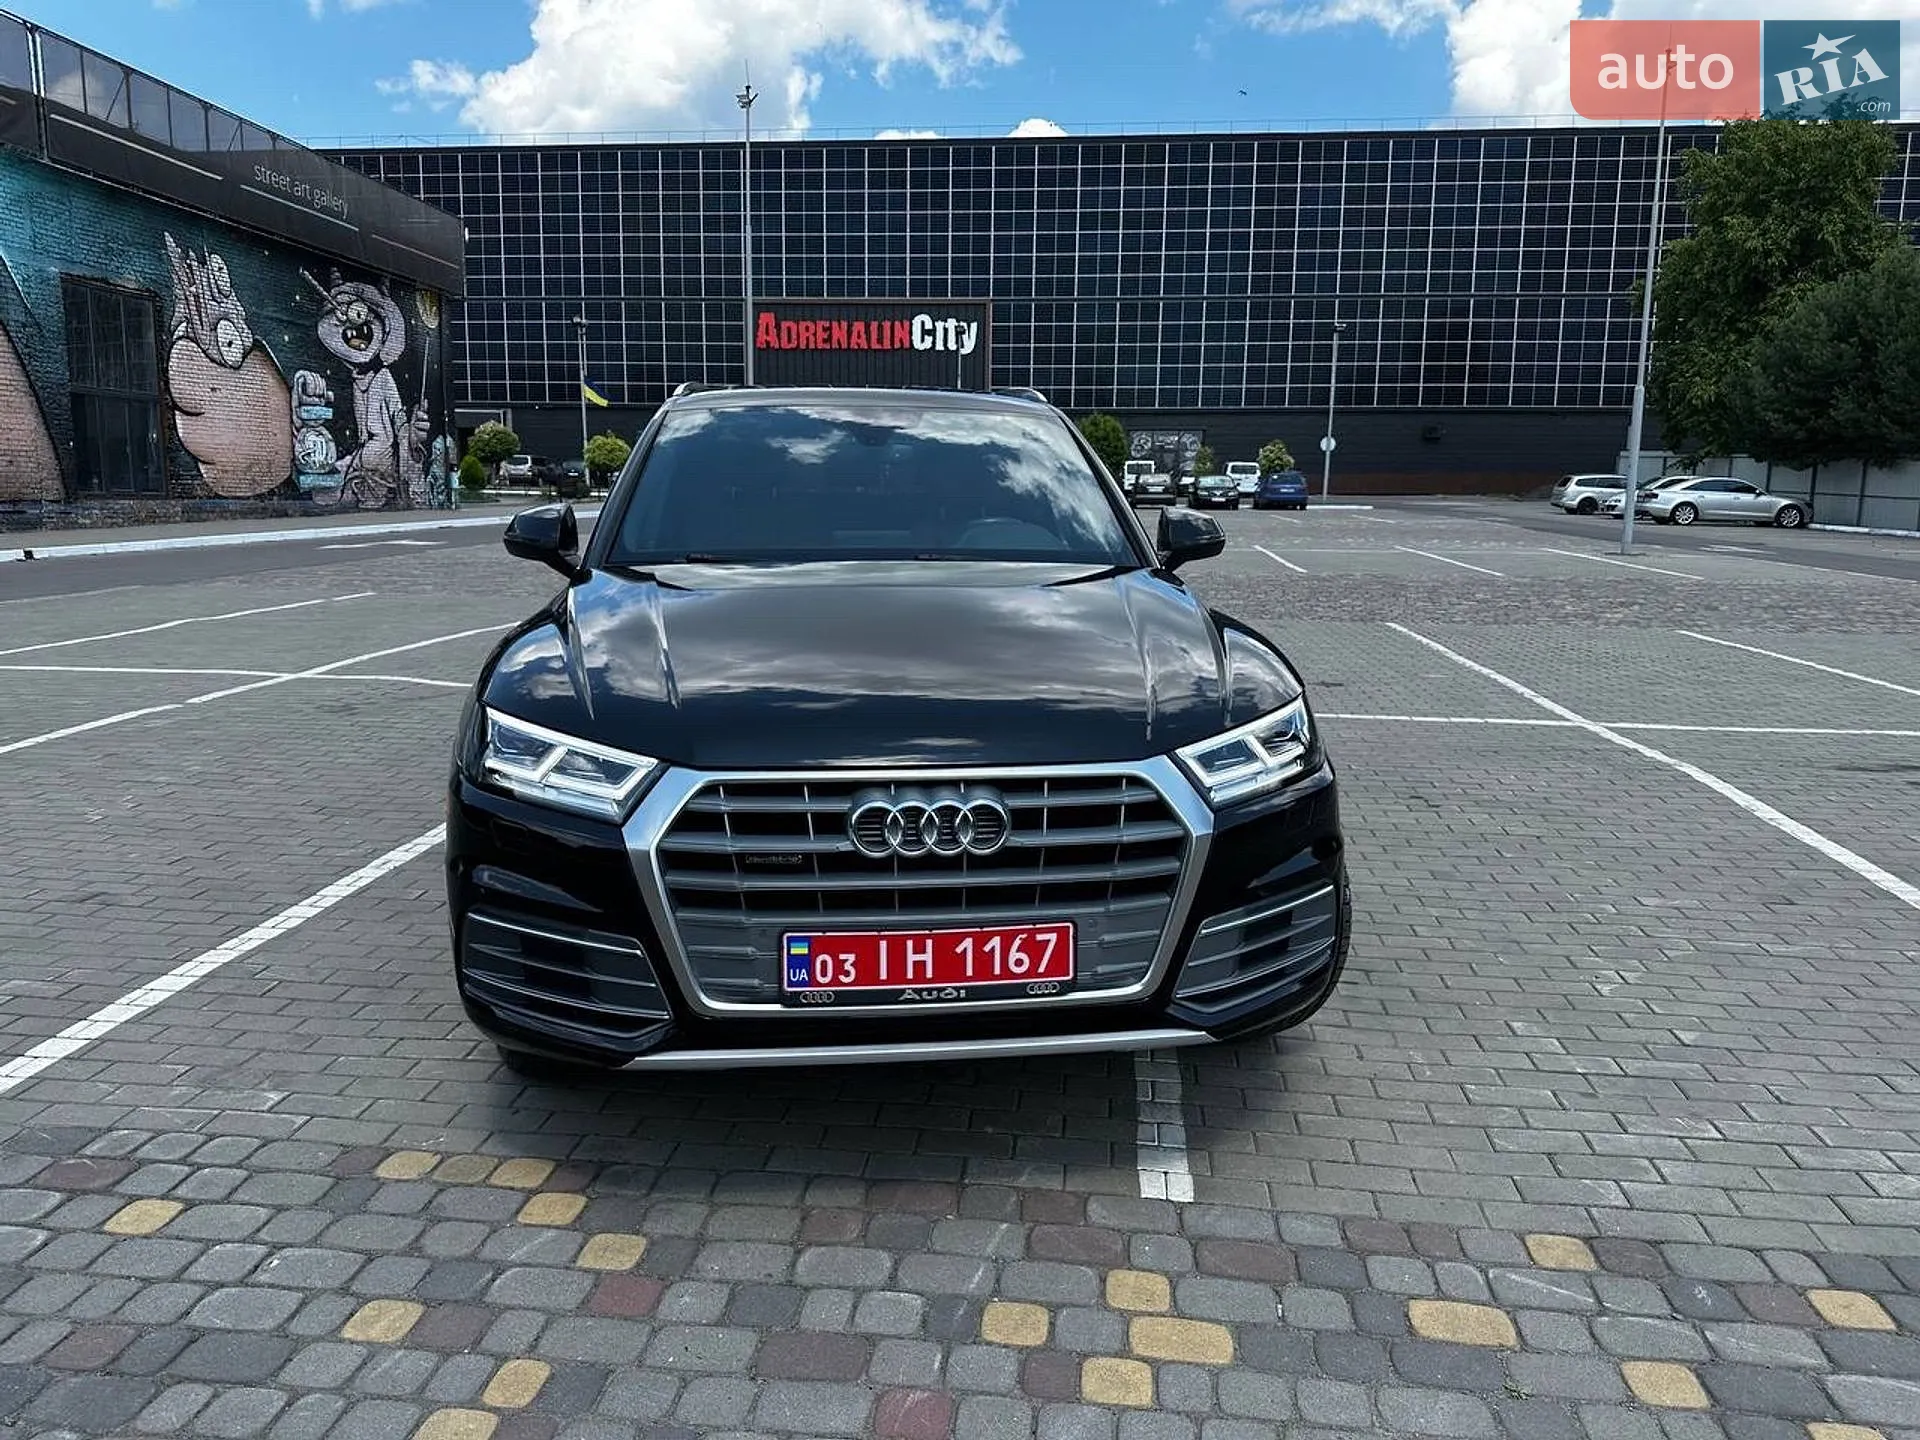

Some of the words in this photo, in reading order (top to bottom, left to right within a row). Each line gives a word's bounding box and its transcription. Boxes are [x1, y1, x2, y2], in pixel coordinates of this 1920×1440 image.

[253, 164, 291, 193] street
[293, 181, 312, 201] art
[313, 183, 348, 220] gallery
[814, 952, 857, 984] 03
[954, 932, 1058, 977] 1167
[789, 968, 809, 982] UA
[899, 986, 967, 1000] Audi
